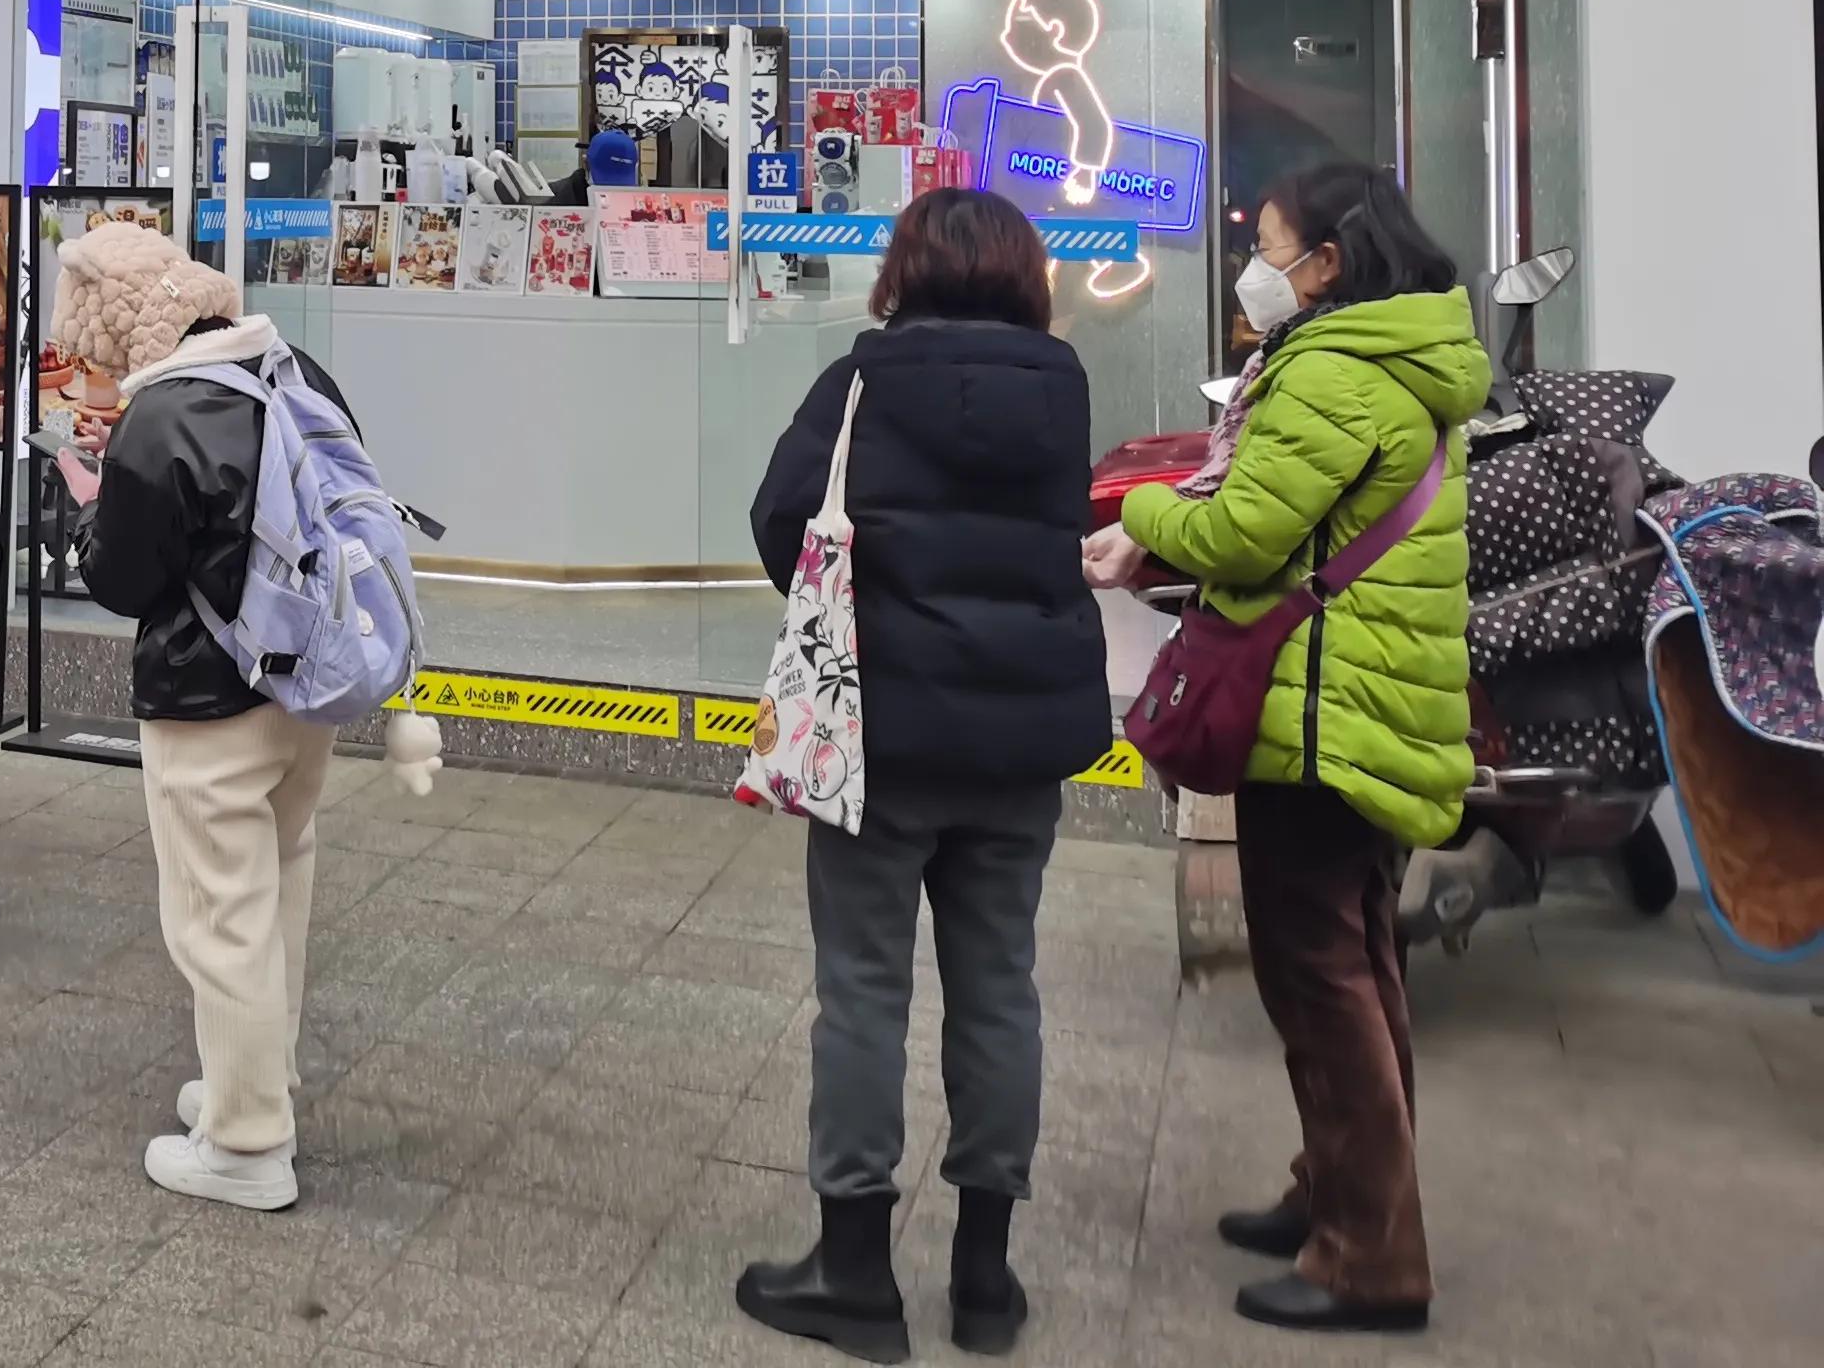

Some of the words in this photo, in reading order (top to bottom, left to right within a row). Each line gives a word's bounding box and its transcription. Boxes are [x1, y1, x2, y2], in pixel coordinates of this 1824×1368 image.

[757, 158, 789, 189] 拉
[1009, 151, 1070, 181] MORE
[754, 198, 790, 210] PULL
[464, 686, 520, 705] 小心台阶
